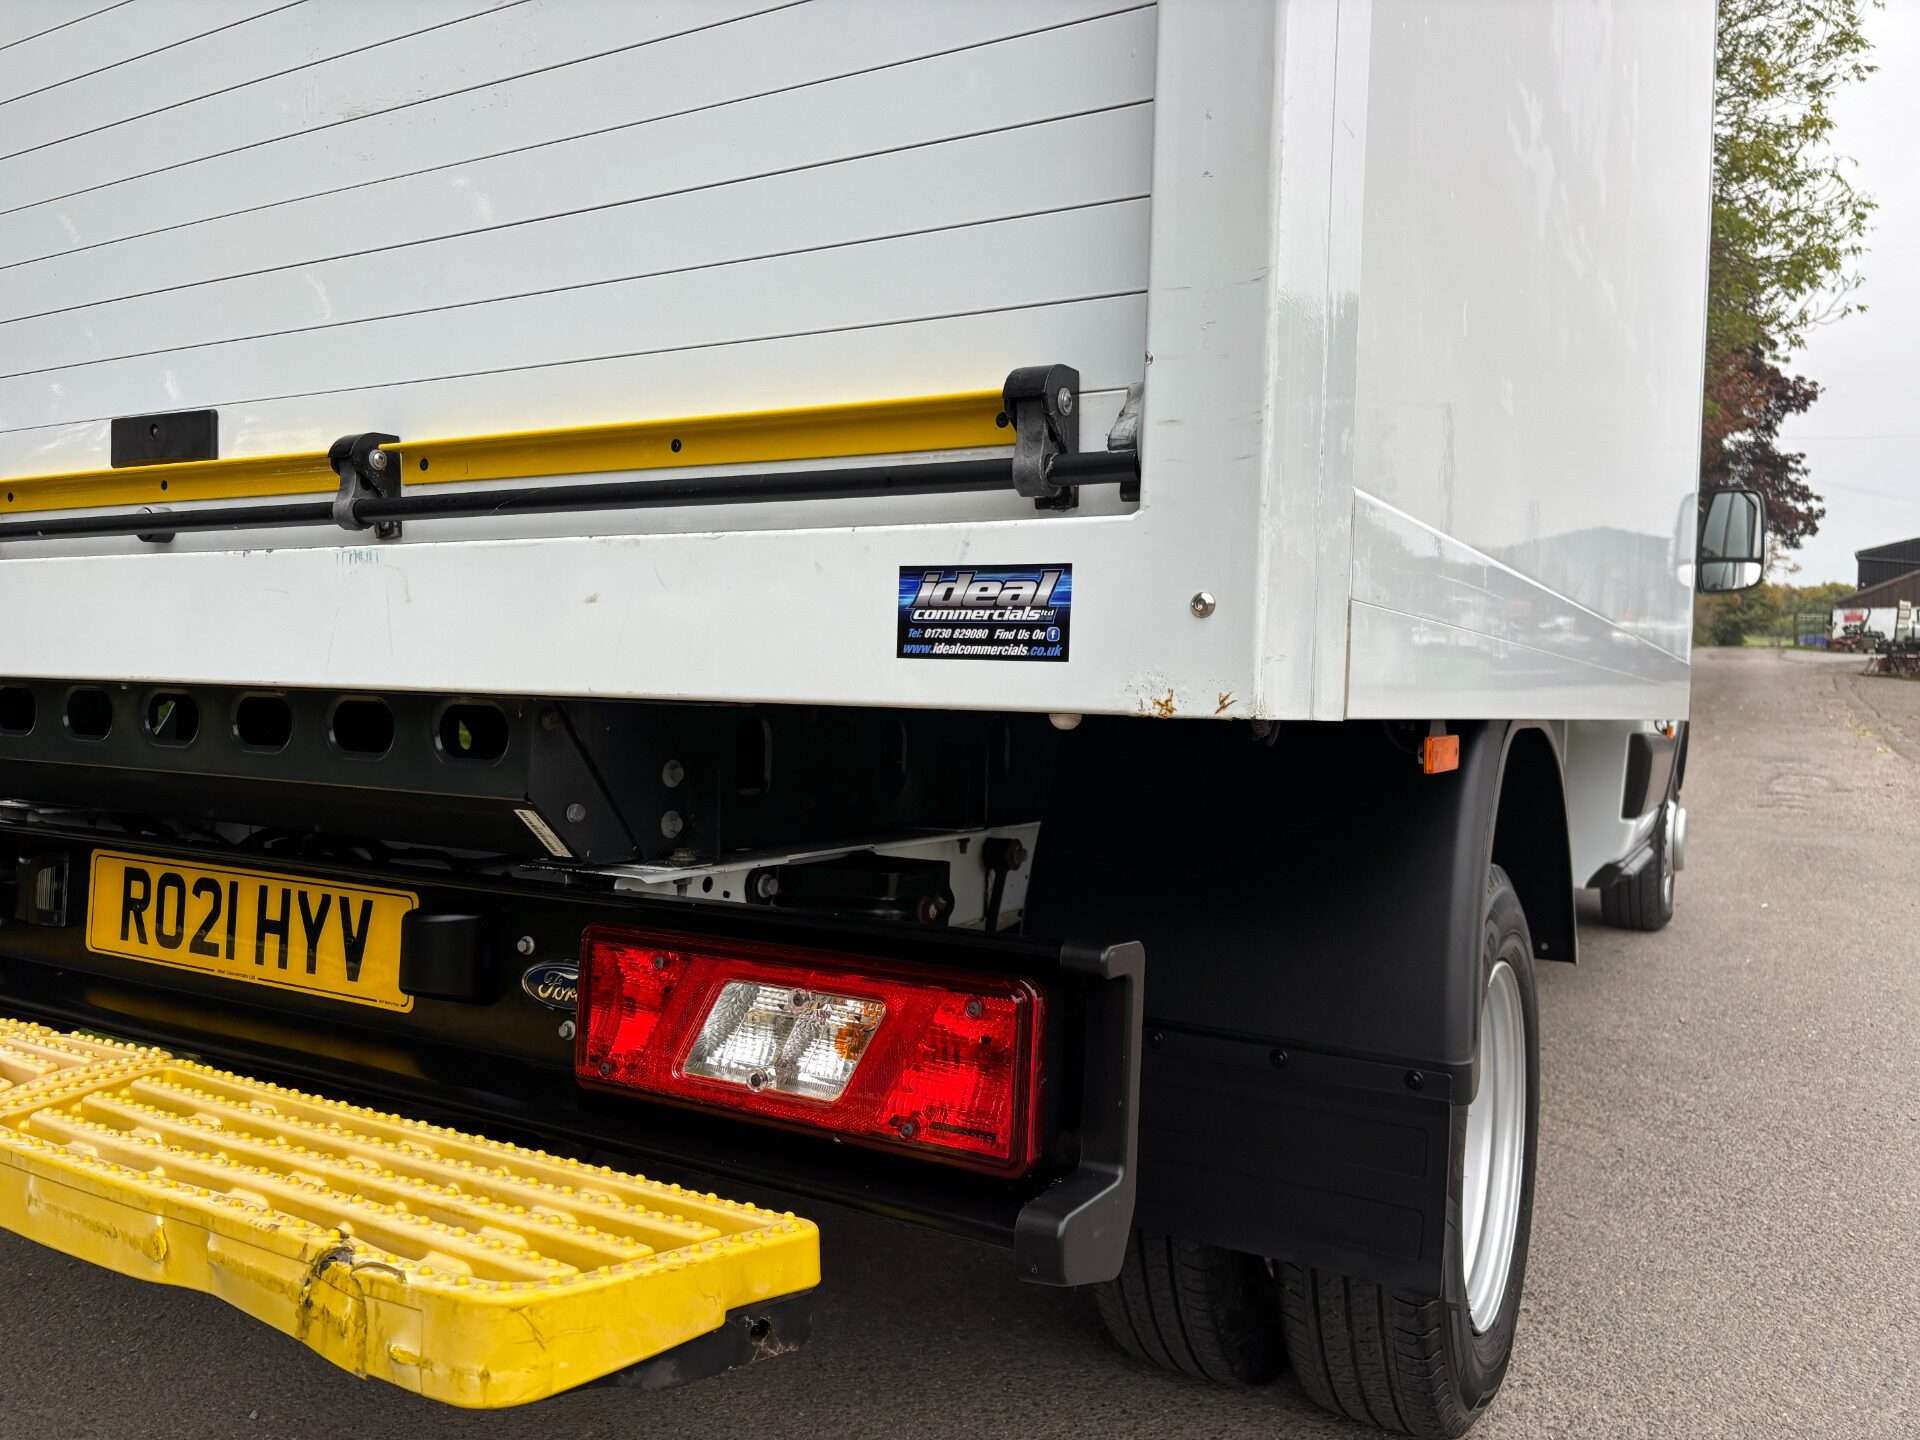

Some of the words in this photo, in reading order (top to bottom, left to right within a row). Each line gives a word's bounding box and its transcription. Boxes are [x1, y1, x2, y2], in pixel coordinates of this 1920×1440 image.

[912, 570, 1063, 607] ideal
[913, 606, 1041, 621] commercials
[908, 628, 924, 638] Tel:
[924, 628, 953, 639] 01730
[953, 628, 989, 640] 829080
[994, 628, 1017, 640] Find
[1017, 629, 1031, 640] Us
[1032, 629, 1046, 640] On
[903, 642, 1063, 657] www.idealcommercials.co.uk
[120, 866, 239, 961] RO21
[255, 884, 374, 982] HYV
[538, 969, 578, 1002] For
